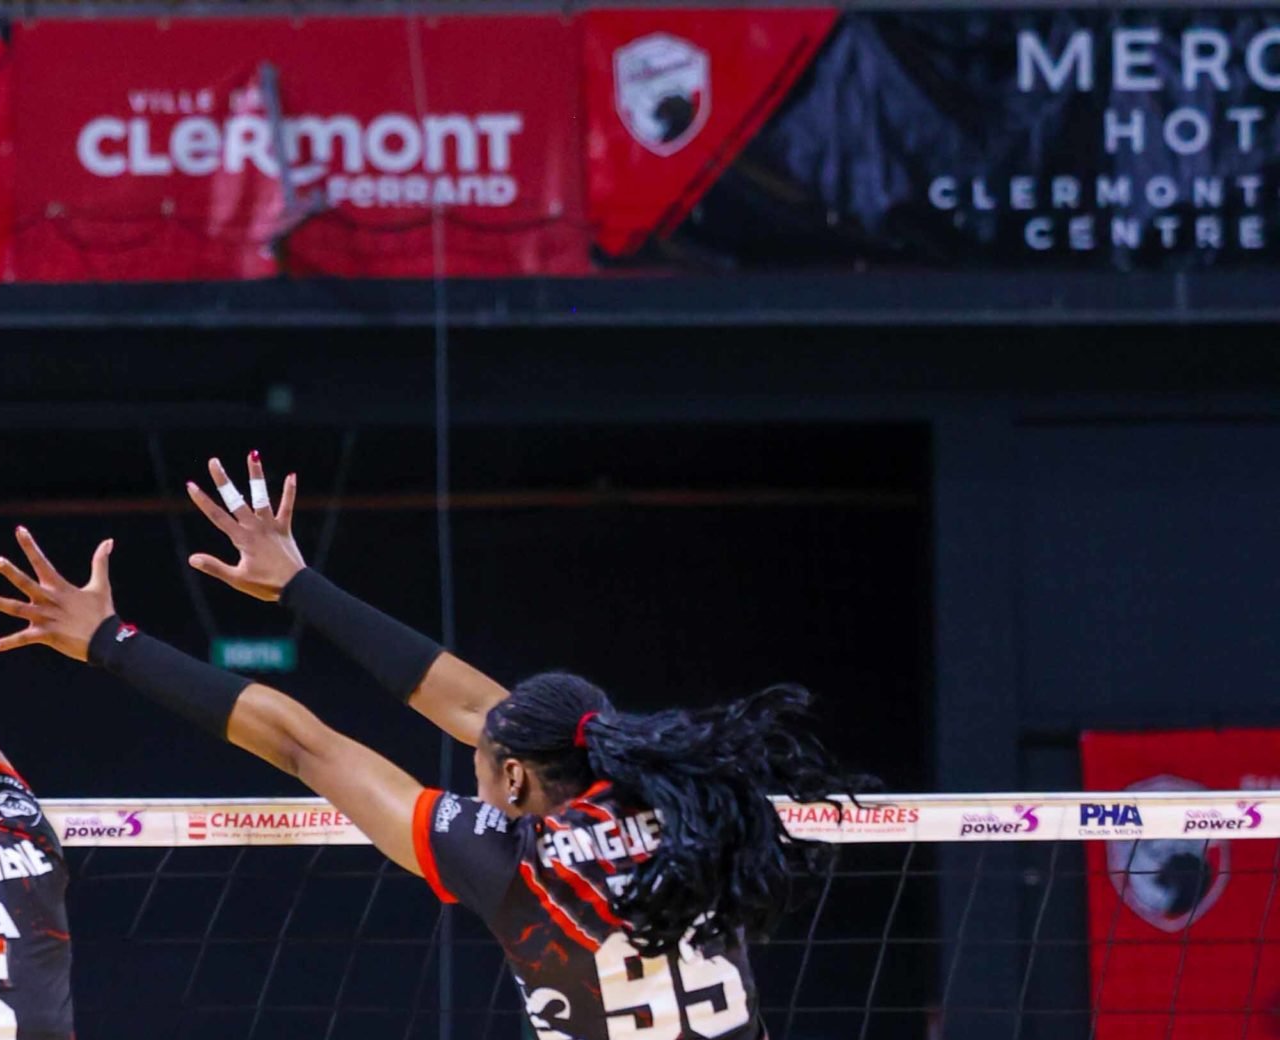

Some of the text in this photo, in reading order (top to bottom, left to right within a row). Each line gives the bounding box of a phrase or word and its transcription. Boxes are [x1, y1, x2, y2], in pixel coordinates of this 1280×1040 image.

[928, 176, 1263, 210] CLERMONT
[1023, 217, 1264, 250] CENTRE
[1079, 803, 1143, 826] PHA
